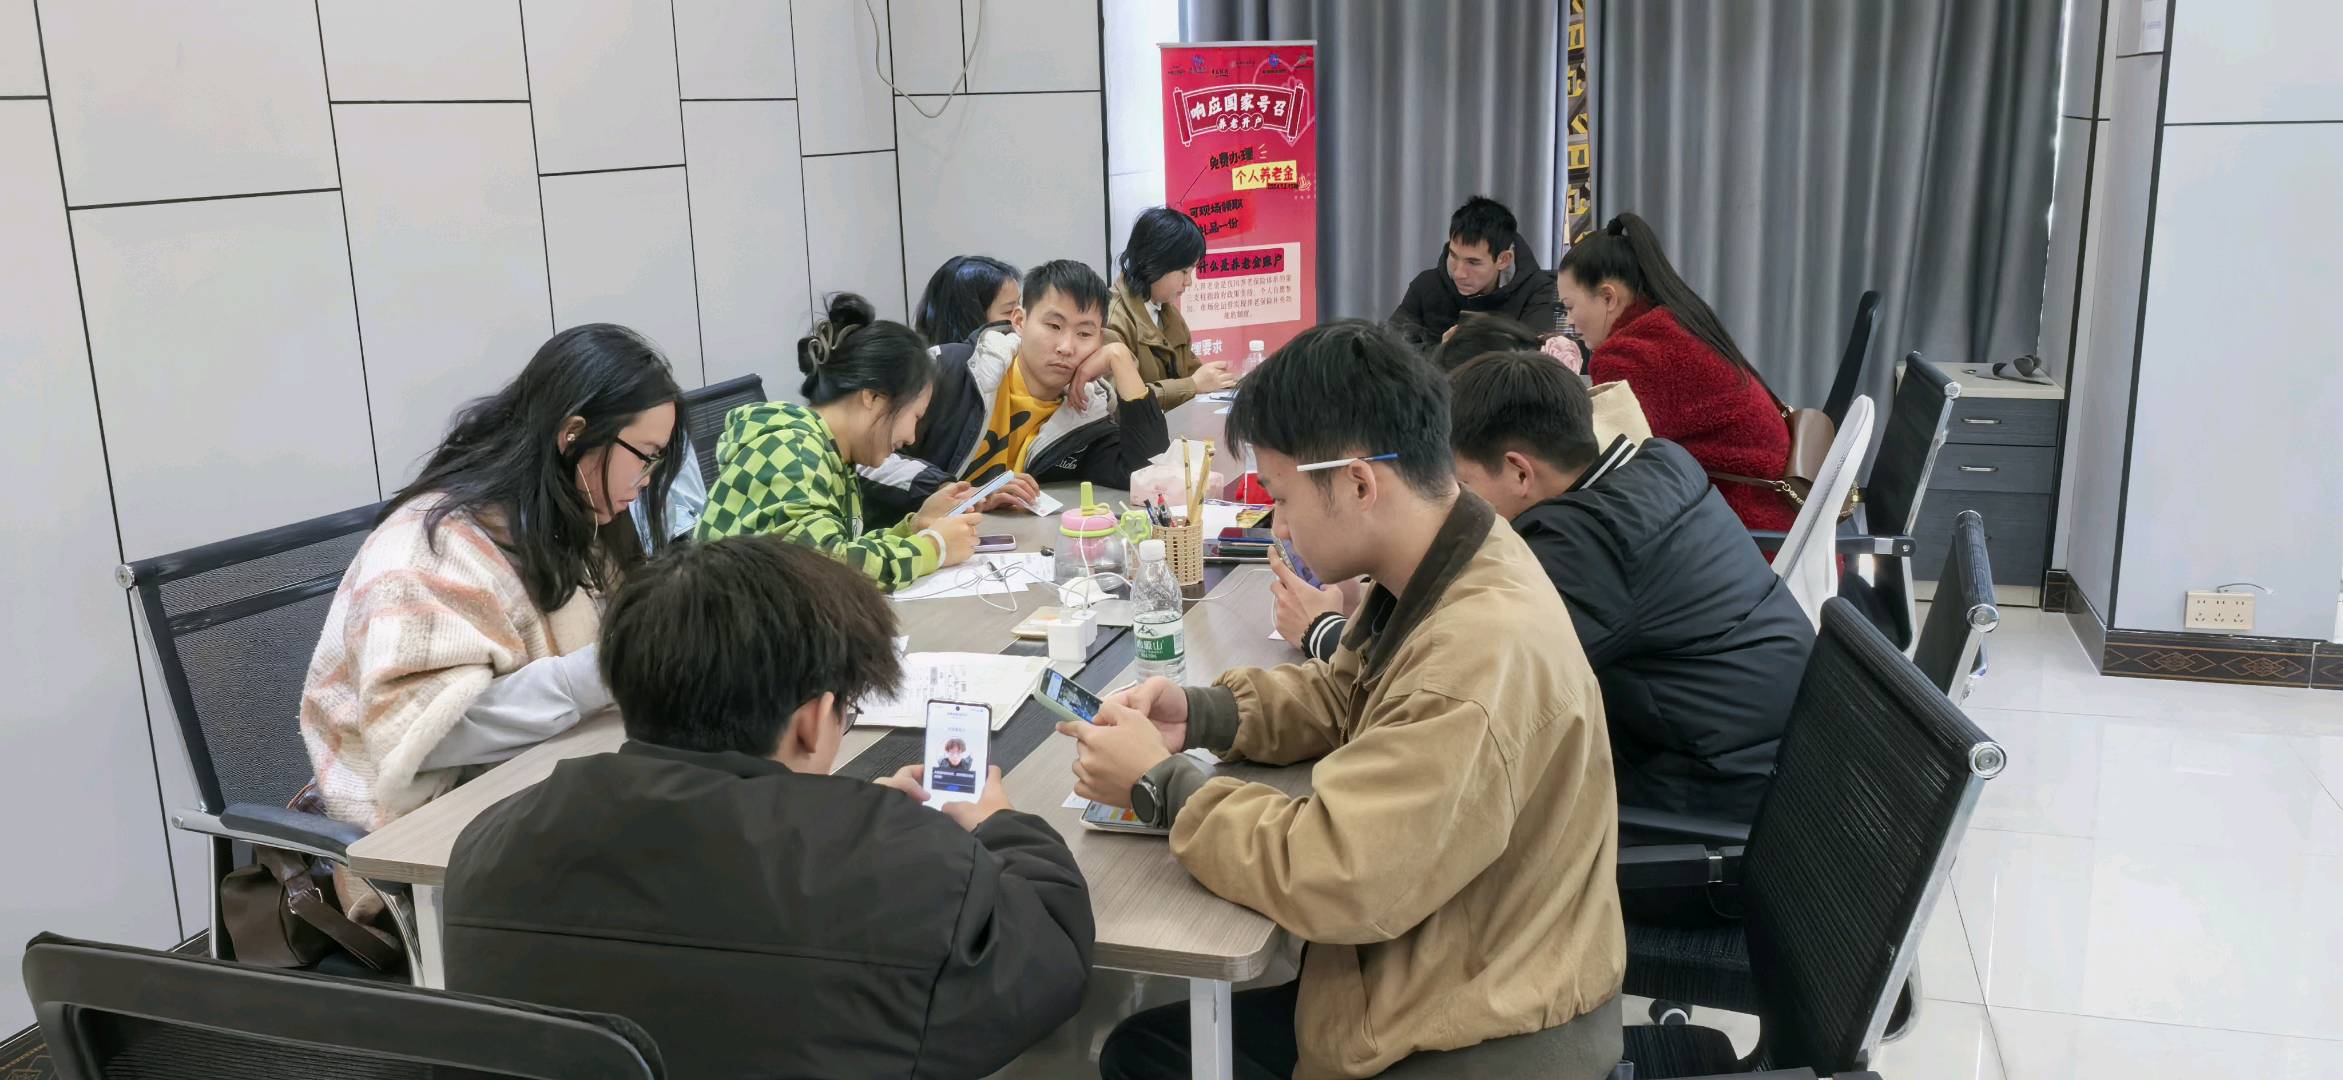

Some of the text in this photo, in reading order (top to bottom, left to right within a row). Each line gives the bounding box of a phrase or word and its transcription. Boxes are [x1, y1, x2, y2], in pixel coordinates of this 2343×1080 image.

[1190, 92, 1287, 120] 响应国家号召
[1217, 115, 1263, 130] 养老开户
[1209, 147, 1254, 170] 免费办理
[1235, 165, 1294, 185] 个人养老金
[1197, 253, 1283, 273] 什么是养老金账户
